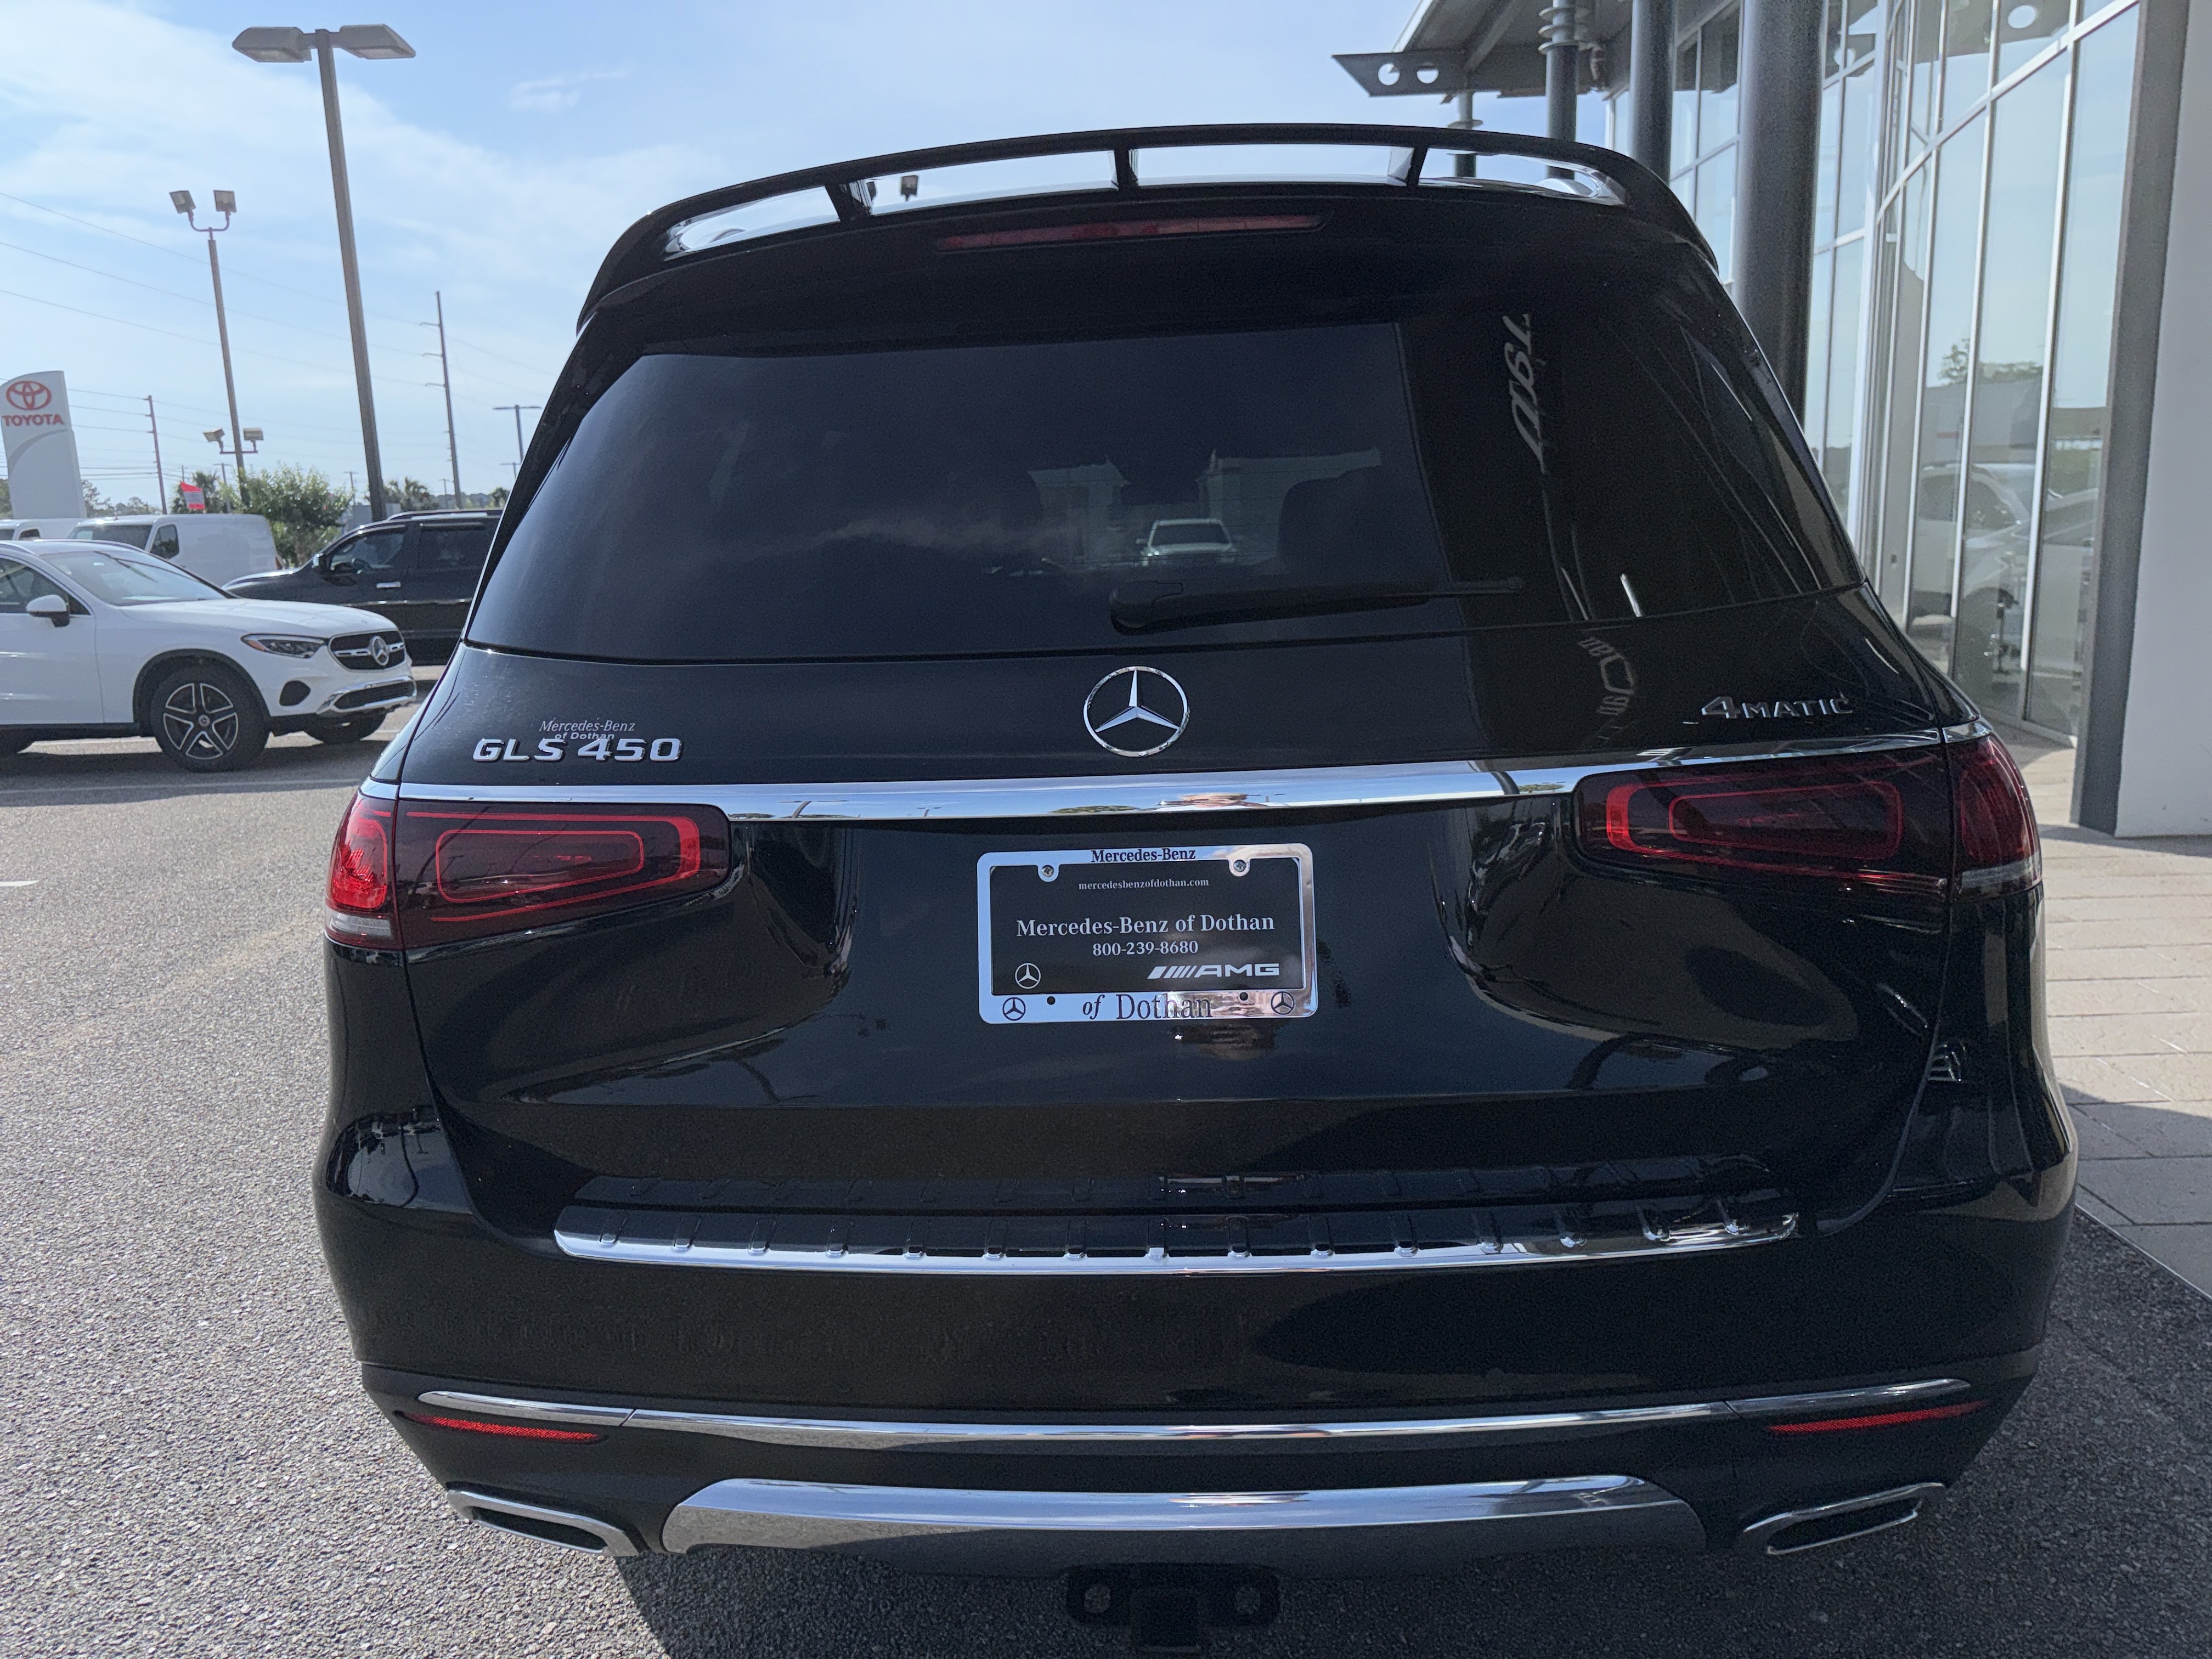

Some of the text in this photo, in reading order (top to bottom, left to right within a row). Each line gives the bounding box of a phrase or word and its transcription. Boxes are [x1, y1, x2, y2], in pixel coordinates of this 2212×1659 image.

[2, 414, 64, 426] TOYOTA
[1701, 696, 1853, 719] 4MATIC
[539, 720, 636, 732] Mercedes-Benz
[473, 737, 683, 762] GLS 450
[1091, 848, 1197, 862] Mercedes-Benz
[1079, 878, 1209, 890] mercedesbenzofdothan.com
[1016, 913, 1276, 936] Mercedes-Benz of Dothan
[1092, 940, 1199, 956] 800-239-8680
[1193, 963, 1280, 978] AMG
[1082, 992, 1214, 1020] of Dothan
